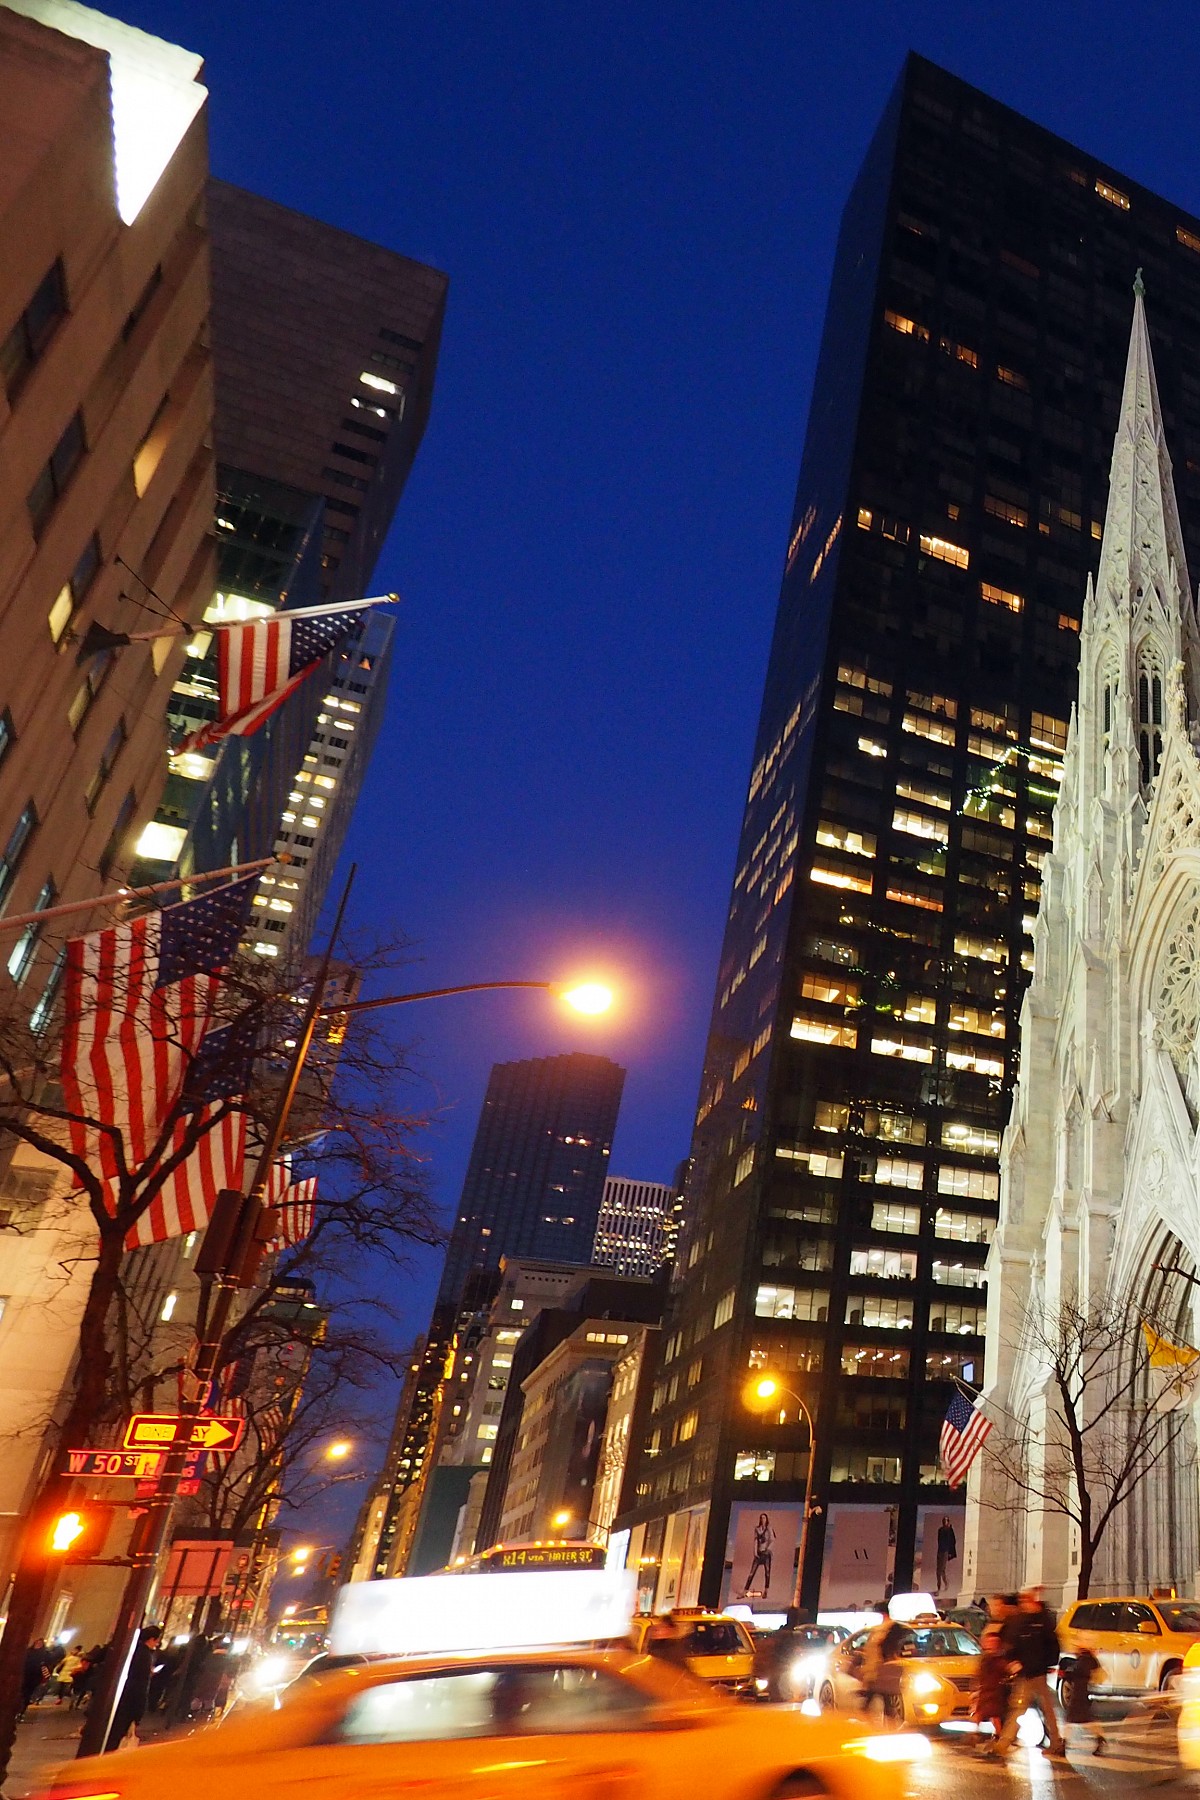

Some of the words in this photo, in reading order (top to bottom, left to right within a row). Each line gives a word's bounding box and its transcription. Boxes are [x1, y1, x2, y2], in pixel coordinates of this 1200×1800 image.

[142, 1426, 172, 1438] ONE
[69, 1453, 88, 1473] W
[92, 1454, 122, 1474] 50
[124, 1455, 140, 1466] ST
